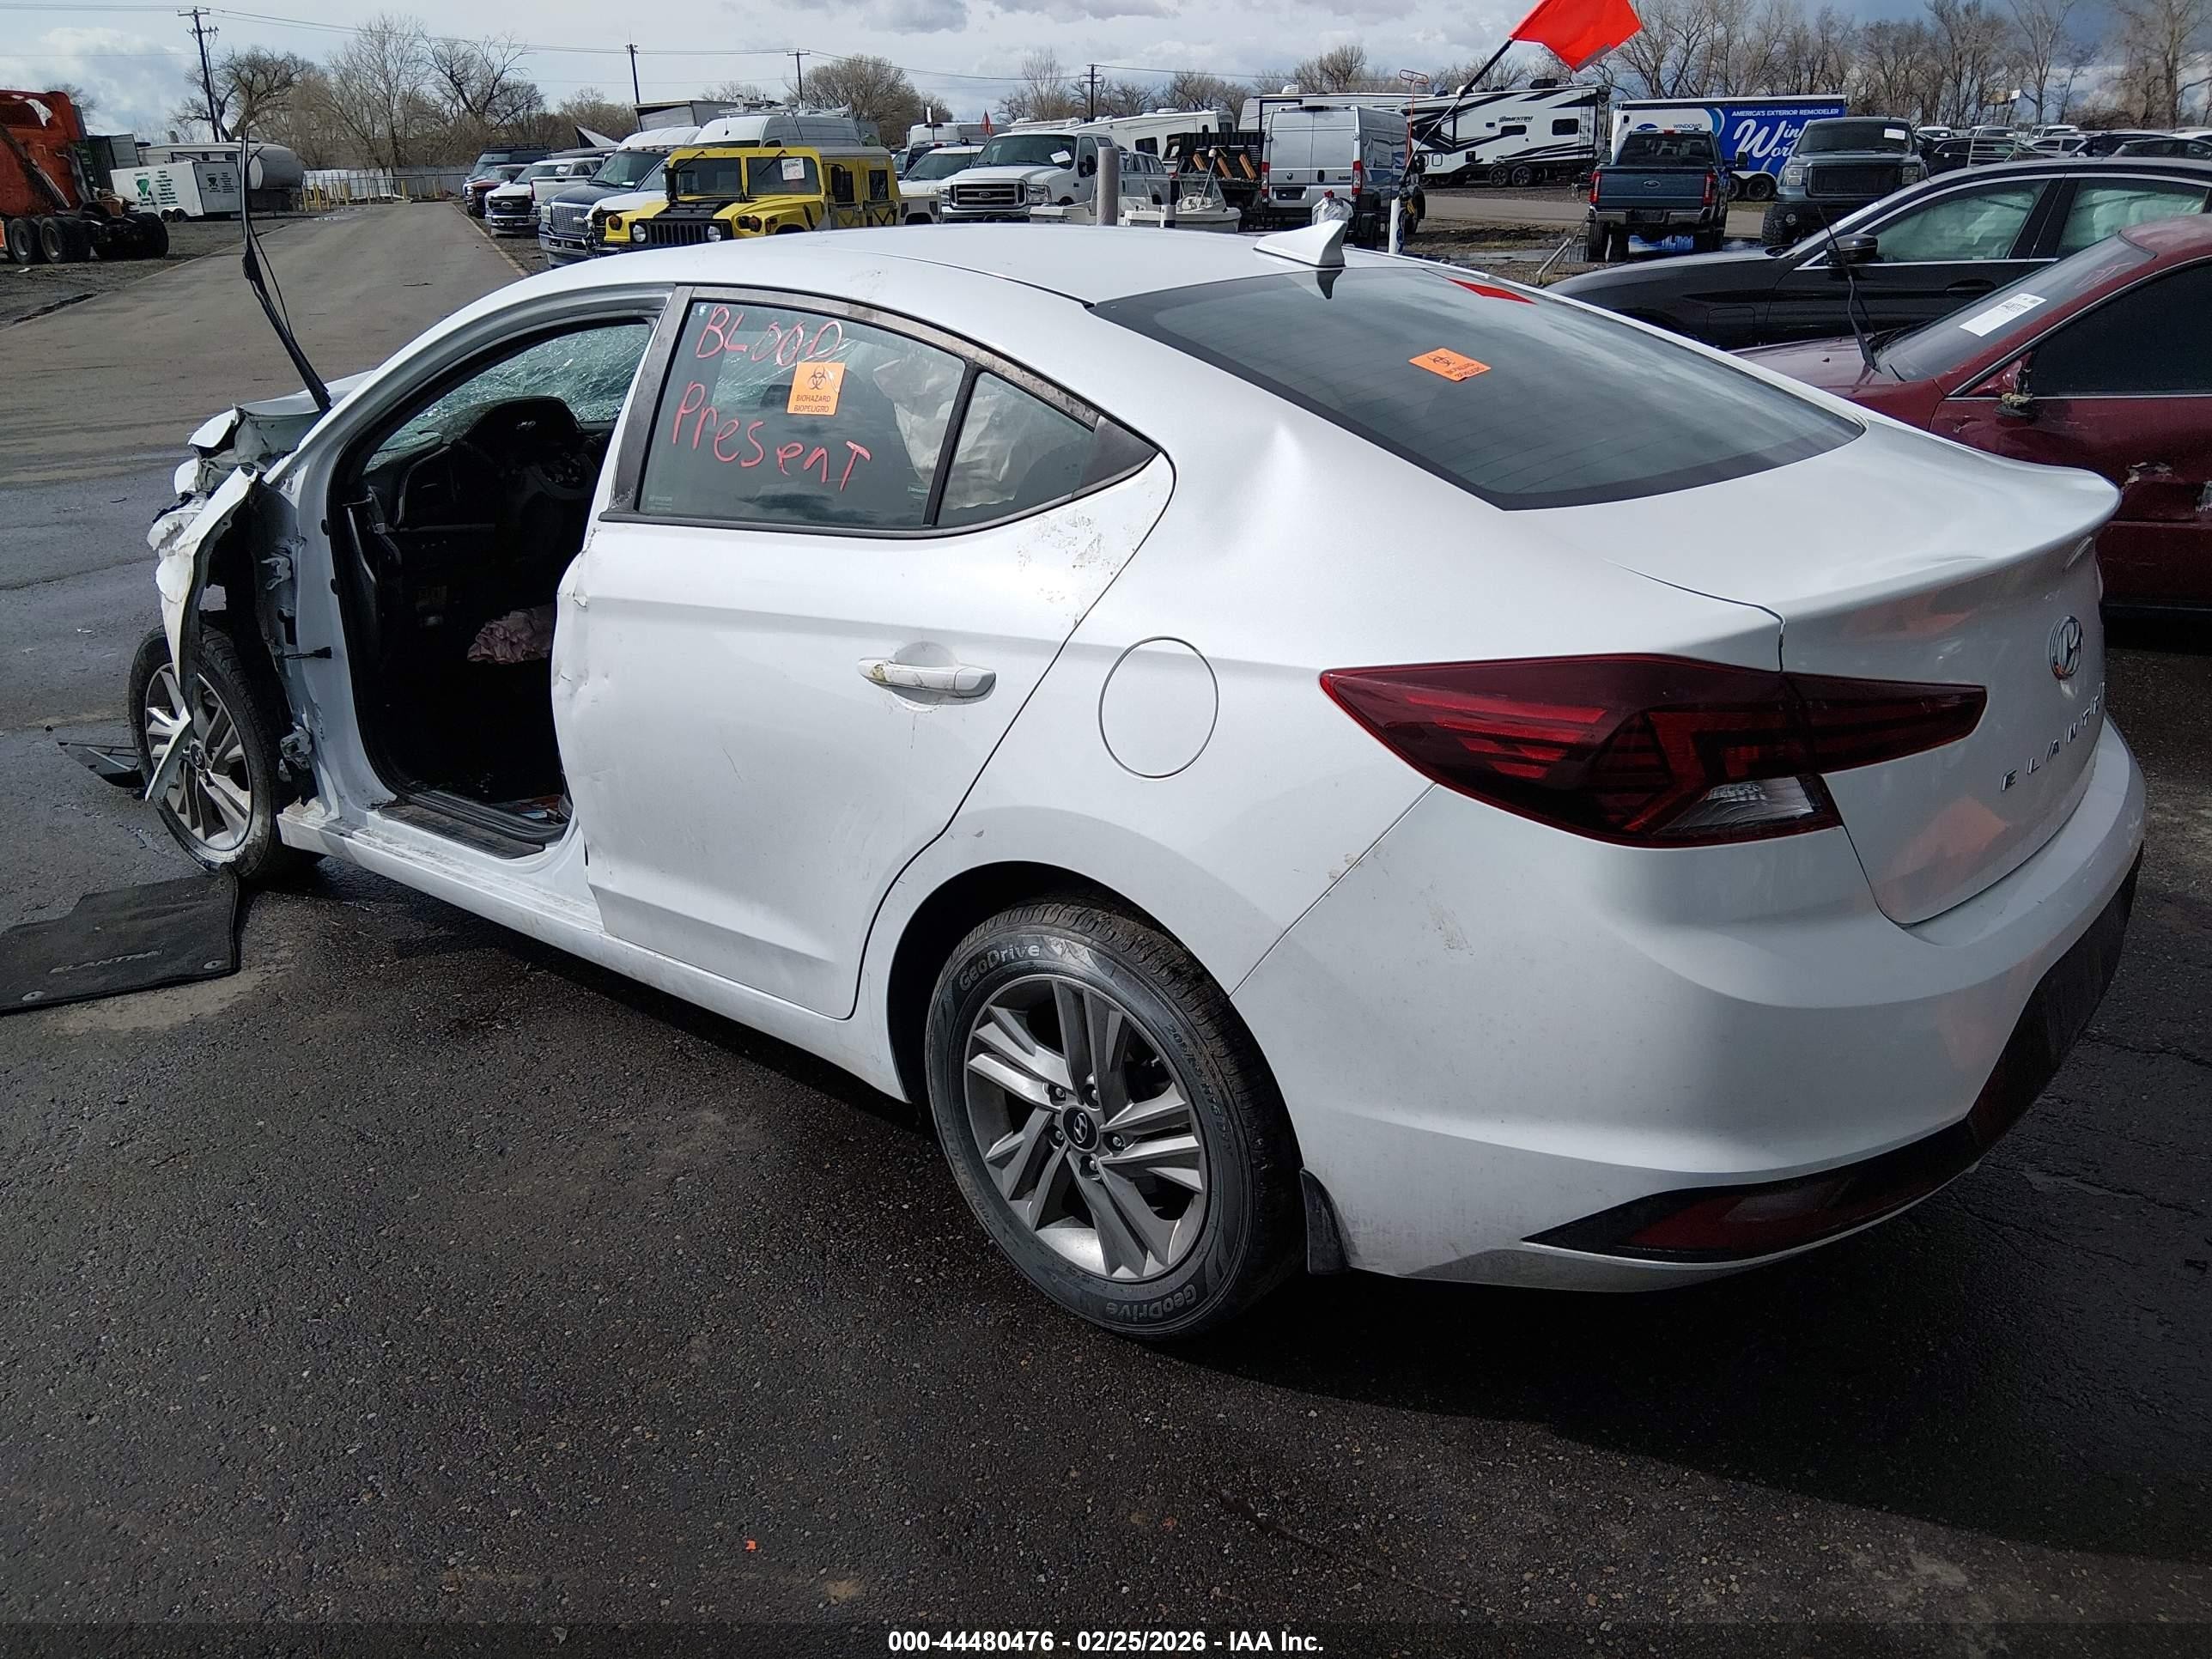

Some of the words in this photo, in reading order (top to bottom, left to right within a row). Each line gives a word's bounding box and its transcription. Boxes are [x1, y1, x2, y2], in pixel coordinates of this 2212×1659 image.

[696, 306, 843, 367] BLOOD
[793, 404, 830, 413] BIOPELIGRO
[796, 394, 831, 403] BIOHAZARD
[959, 945, 1040, 991] GeoDrive
[1105, 1284, 1197, 1322] GeoDrive
